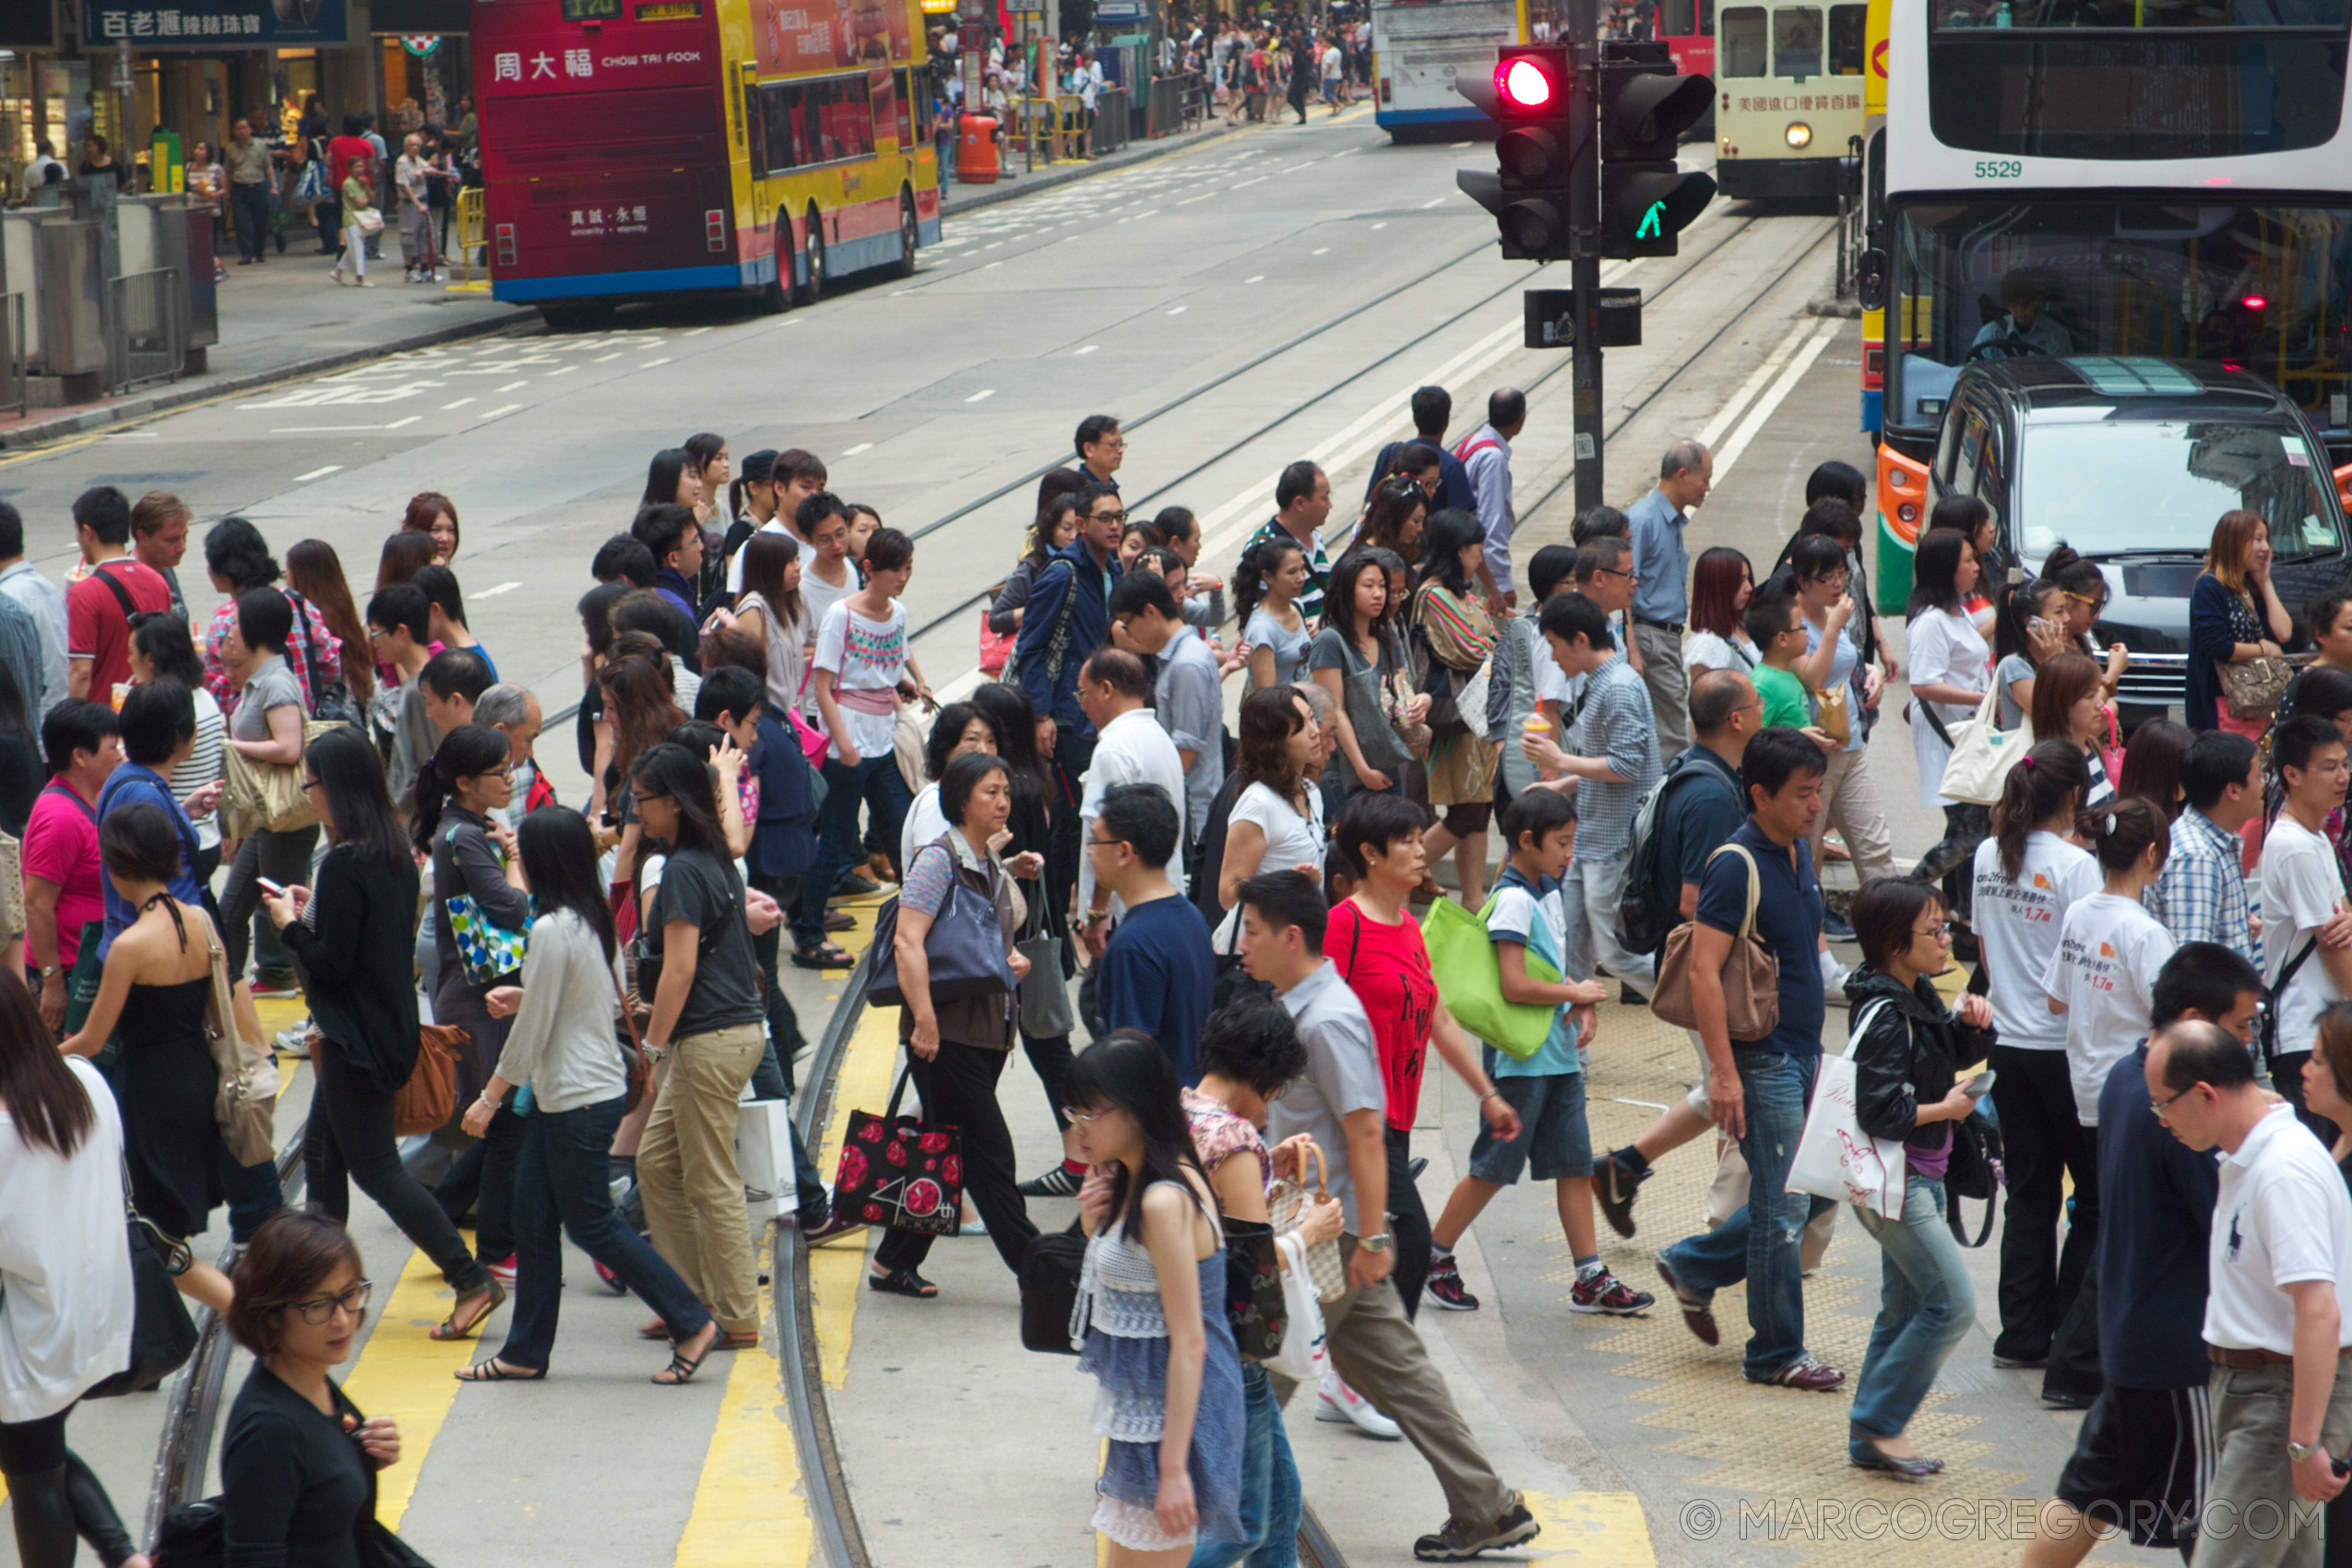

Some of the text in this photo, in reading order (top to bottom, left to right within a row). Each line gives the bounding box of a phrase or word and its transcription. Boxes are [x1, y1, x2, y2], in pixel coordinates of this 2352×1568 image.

[494, 49, 594, 81] 周大福
[601, 52, 701, 67] CHOW TAI FOOK
[1975, 160, 2022, 178] 5529
[1518, 637, 1530, 672] GOSEN
